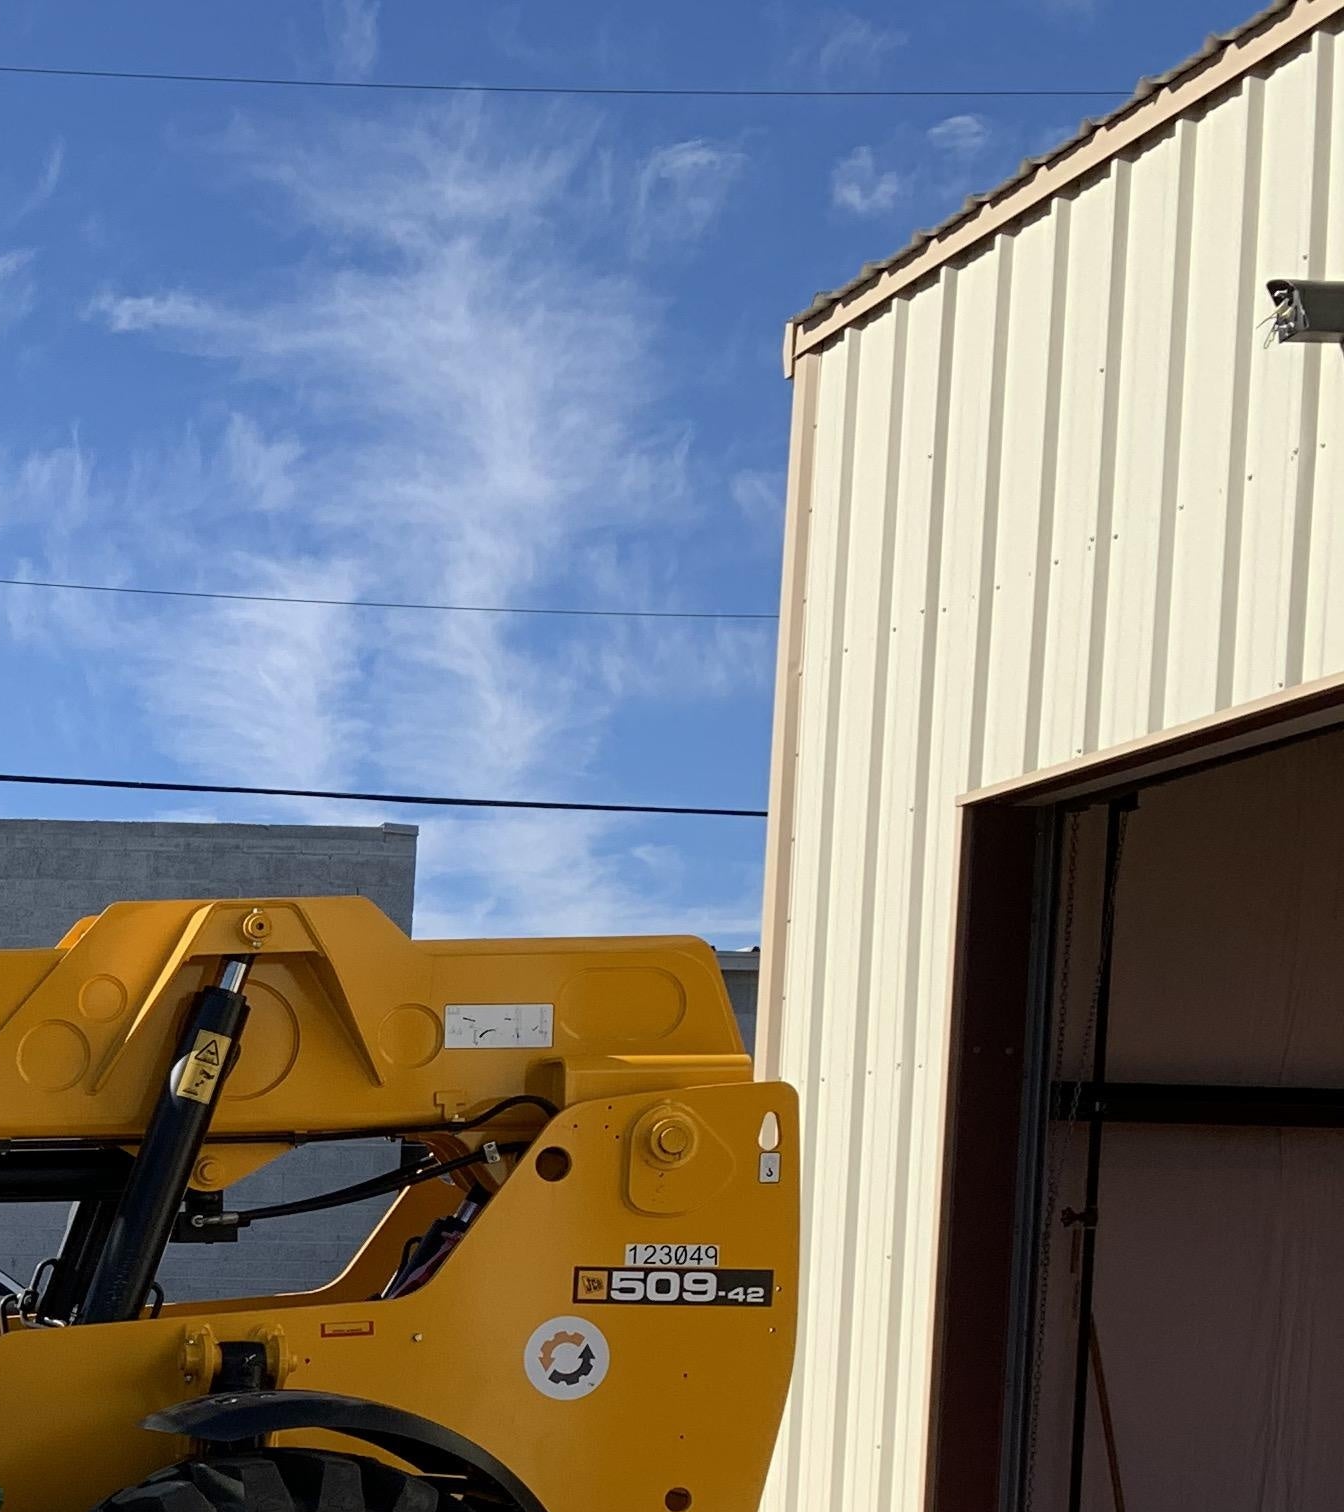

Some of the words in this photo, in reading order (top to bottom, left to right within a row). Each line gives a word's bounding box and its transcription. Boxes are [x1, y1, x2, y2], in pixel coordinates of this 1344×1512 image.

[628, 1244, 719, 1266] 123049
[583, 1276, 603, 1294] JCB
[610, 1270, 765, 1303] 509-42
